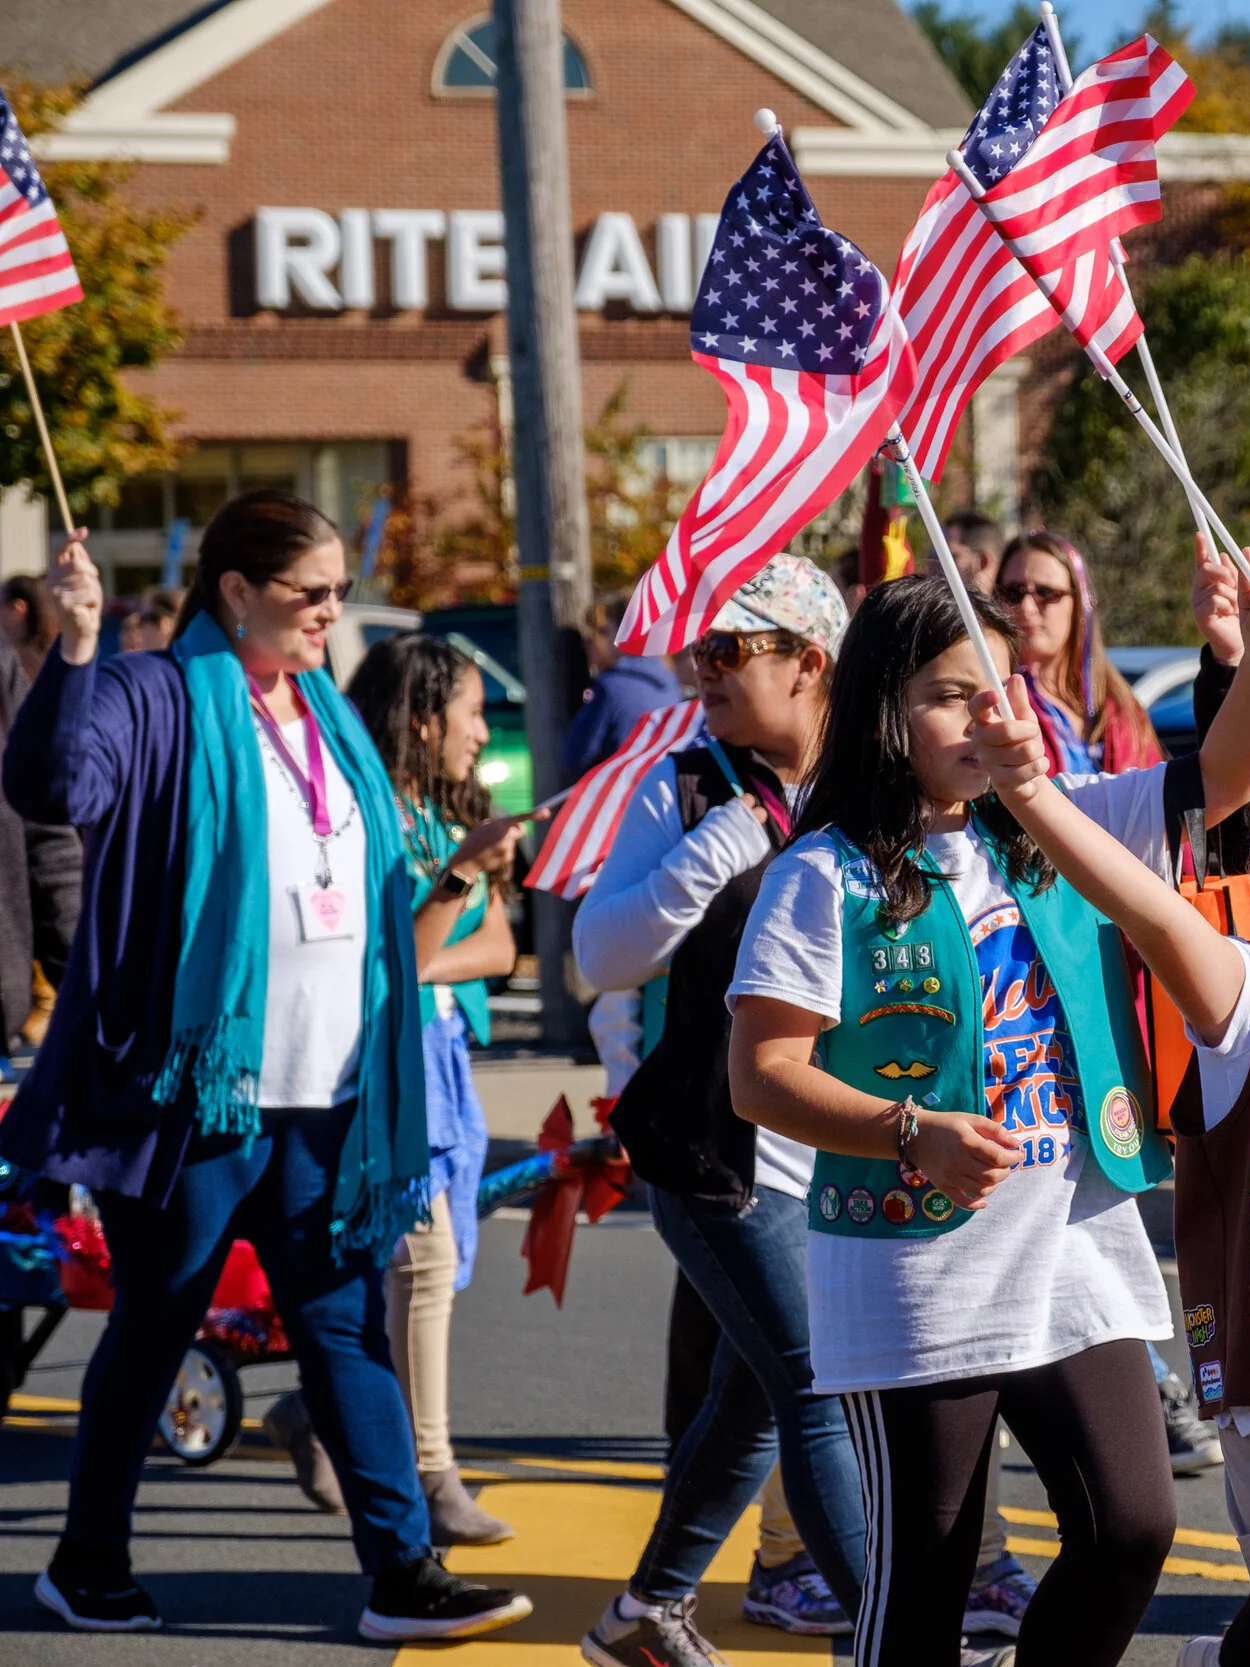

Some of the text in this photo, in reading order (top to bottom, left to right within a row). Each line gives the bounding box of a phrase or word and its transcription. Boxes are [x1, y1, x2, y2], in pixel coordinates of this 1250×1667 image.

[256, 206, 508, 312] RITE
[873, 945, 931, 970] 343
[1113, 1142, 1127, 1155] TRY
